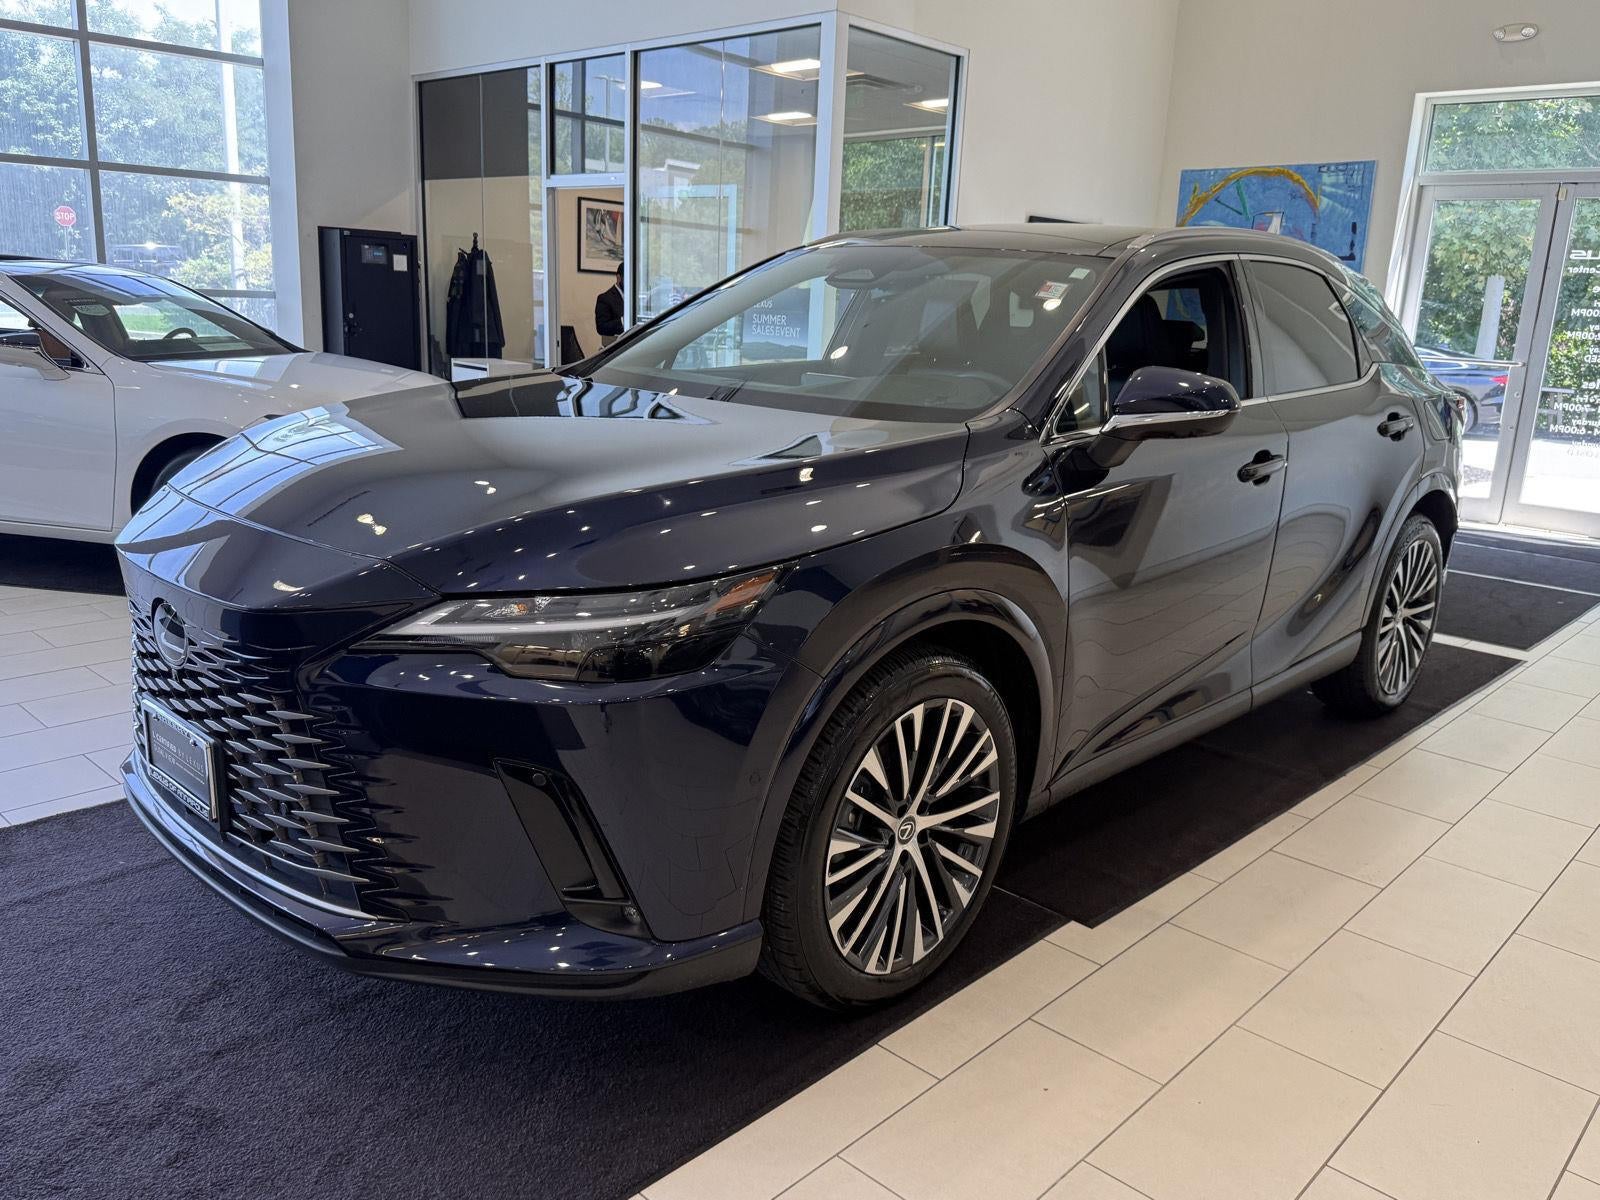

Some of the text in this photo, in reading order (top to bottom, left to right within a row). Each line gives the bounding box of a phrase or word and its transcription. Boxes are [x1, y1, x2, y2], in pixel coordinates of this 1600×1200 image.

[56, 212, 75, 220] STOP
[752, 314, 787, 325] SUMMER
[752, 325, 801, 338] SALES EVENT
